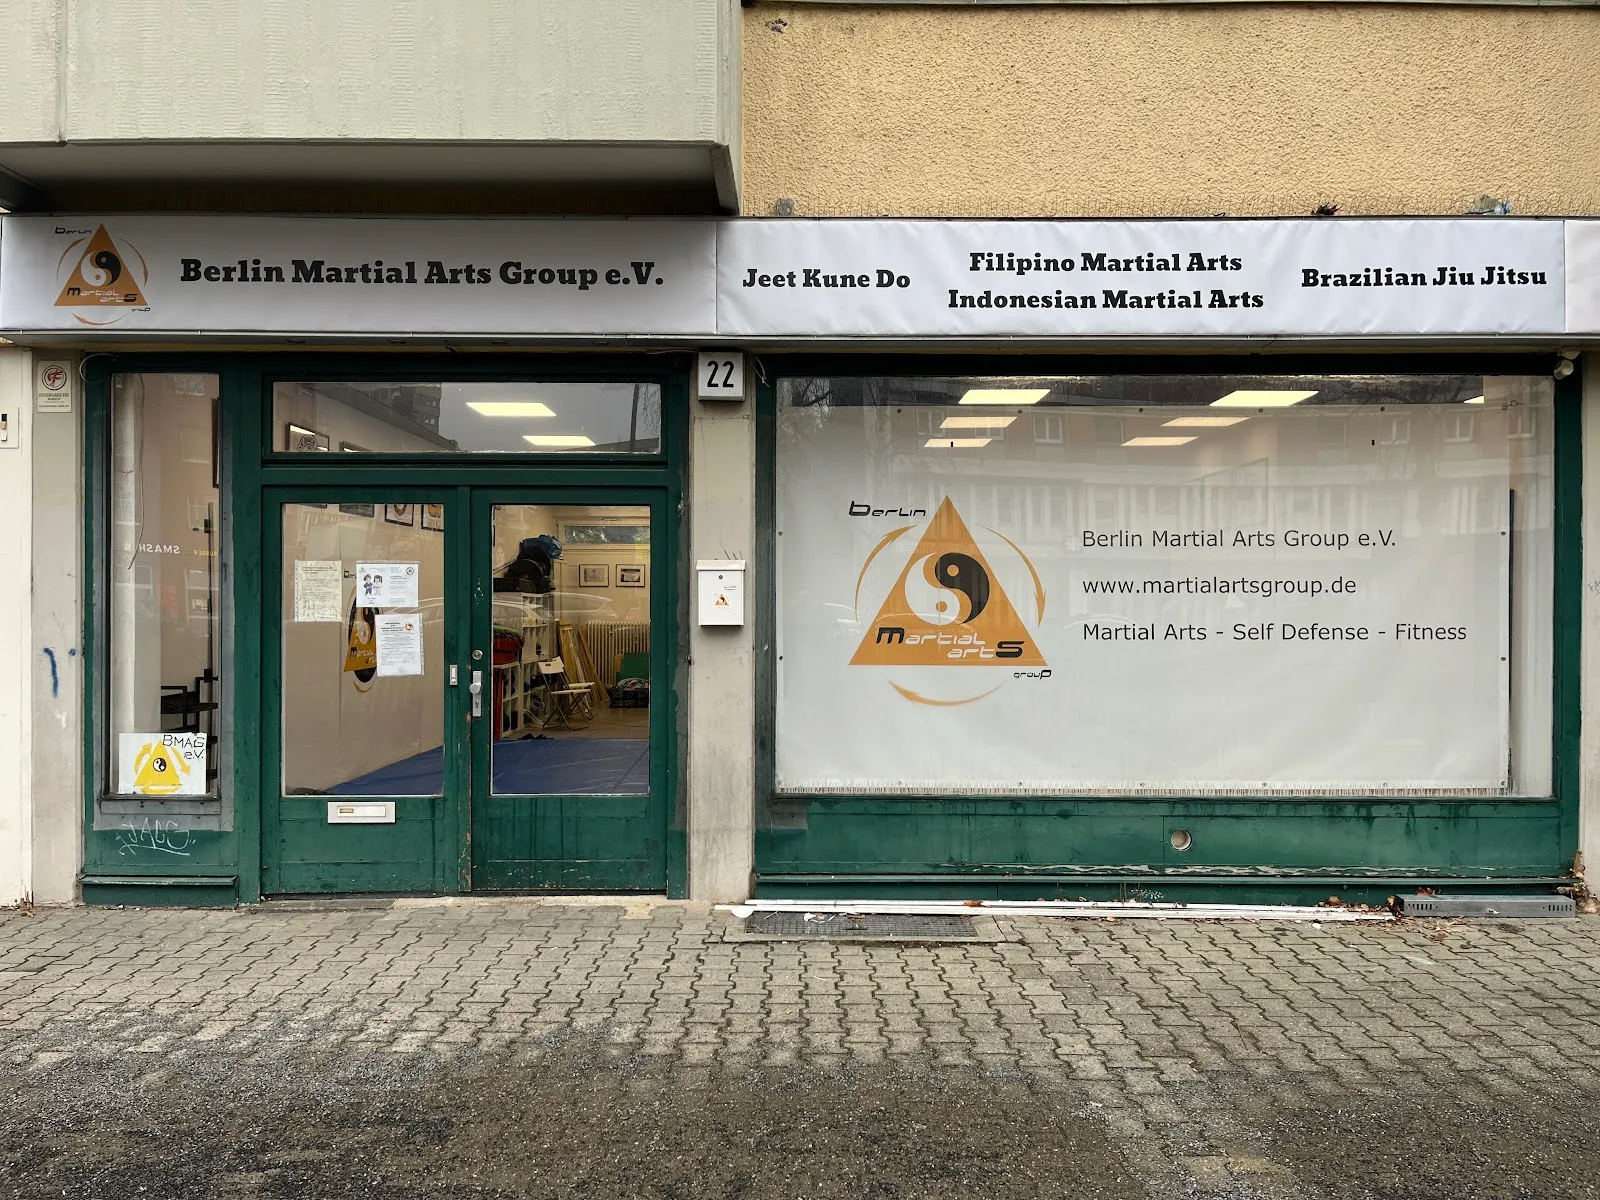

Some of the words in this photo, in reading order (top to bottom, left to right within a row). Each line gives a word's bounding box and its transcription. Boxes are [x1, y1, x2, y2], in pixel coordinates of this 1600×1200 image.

[970, 253, 1074, 275] Filipino
[1081, 253, 1181, 271] Martial
[1187, 253, 1242, 271] Arts
[181, 259, 285, 282] Berlin
[292, 260, 417, 284] Martial
[424, 261, 491, 284] Arts
[499, 261, 598, 291] Group
[605, 262, 664, 285] e.V.
[743, 269, 796, 287] Jeet
[803, 269, 870, 287] Kune
[876, 270, 911, 288] Do
[1302, 267, 1427, 287] Brazilian
[1433, 267, 1474, 285] Jiu
[1481, 266, 1547, 285] Jitsu
[949, 290, 1096, 309] Indonesian
[1103, 290, 1202, 308] Martial
[1208, 290, 1263, 308] Arts
[706, 360, 735, 388] 22
[1083, 530, 1143, 547] Berlin
[1152, 530, 1223, 547] Martial
[1232, 530, 1275, 547] Arts
[1285, 530, 1349, 551] Group
[1358, 530, 1396, 547] e.V.
[1083, 576, 1356, 598] www.martialartsgroup.de
[1083, 624, 1155, 641] Martial
[1164, 624, 1207, 641] Arts
[1233, 623, 1275, 641] Self
[1283, 623, 1369, 641] Defense
[1396, 623, 1467, 641] Fitness
[162, 734, 205, 749] BMAG
